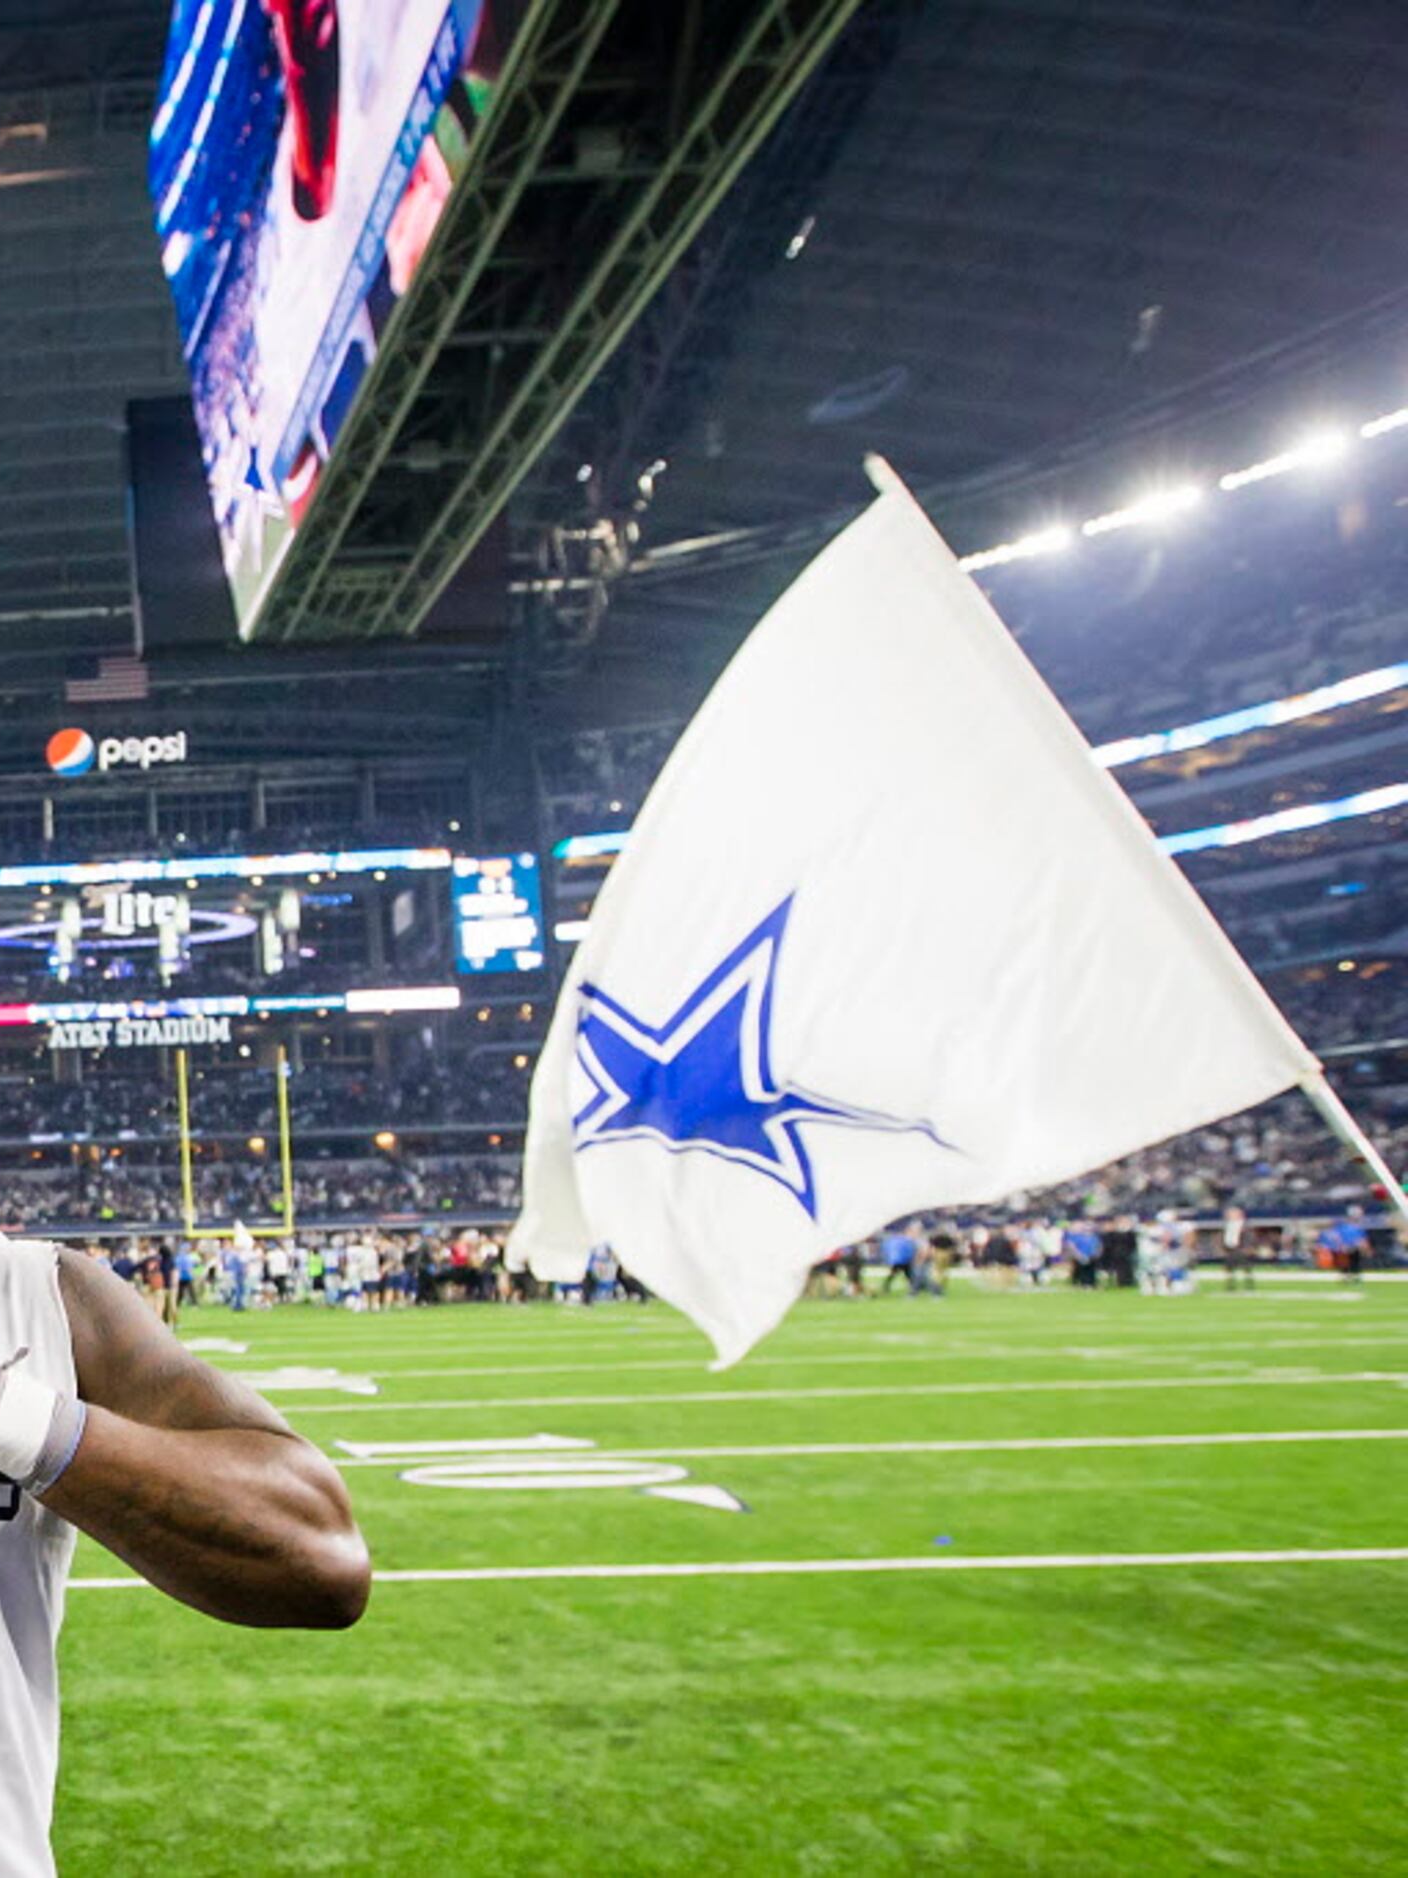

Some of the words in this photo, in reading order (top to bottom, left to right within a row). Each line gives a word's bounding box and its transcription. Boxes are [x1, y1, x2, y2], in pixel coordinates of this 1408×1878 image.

[99, 731, 187, 771] pepsi
[48, 1019, 113, 1048] AT&T
[115, 1016, 232, 1046] STADIUM
